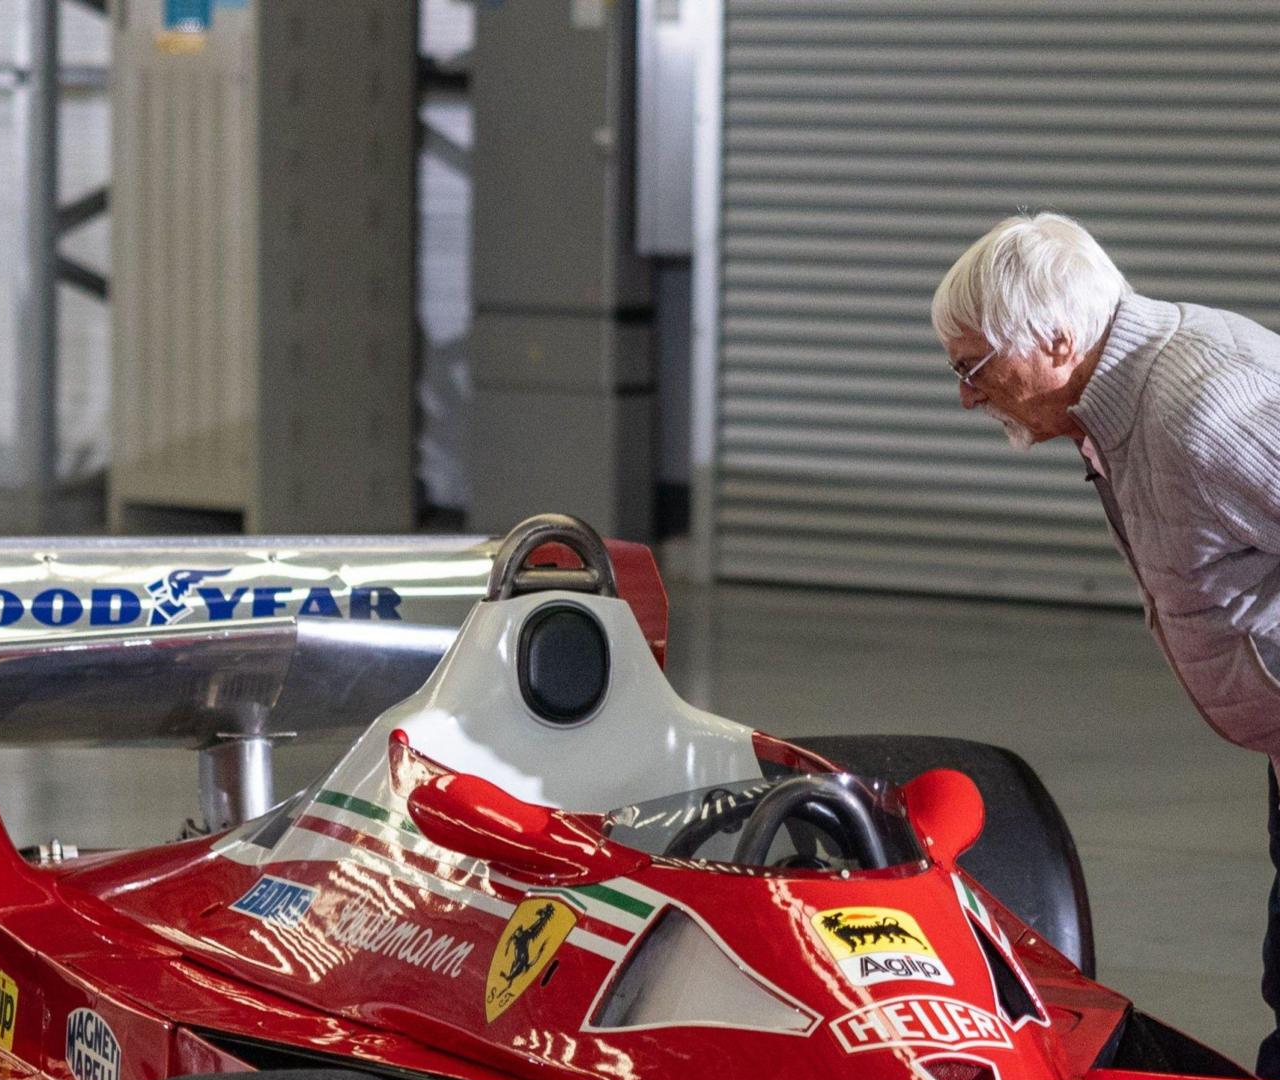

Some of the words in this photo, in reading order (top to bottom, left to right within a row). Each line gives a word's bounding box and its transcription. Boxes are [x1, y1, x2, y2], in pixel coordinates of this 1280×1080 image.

[859, 955, 941, 979] Agip
[66, 1010, 120, 1068] MAGNETI
[847, 1000, 1001, 1042] HEUER
